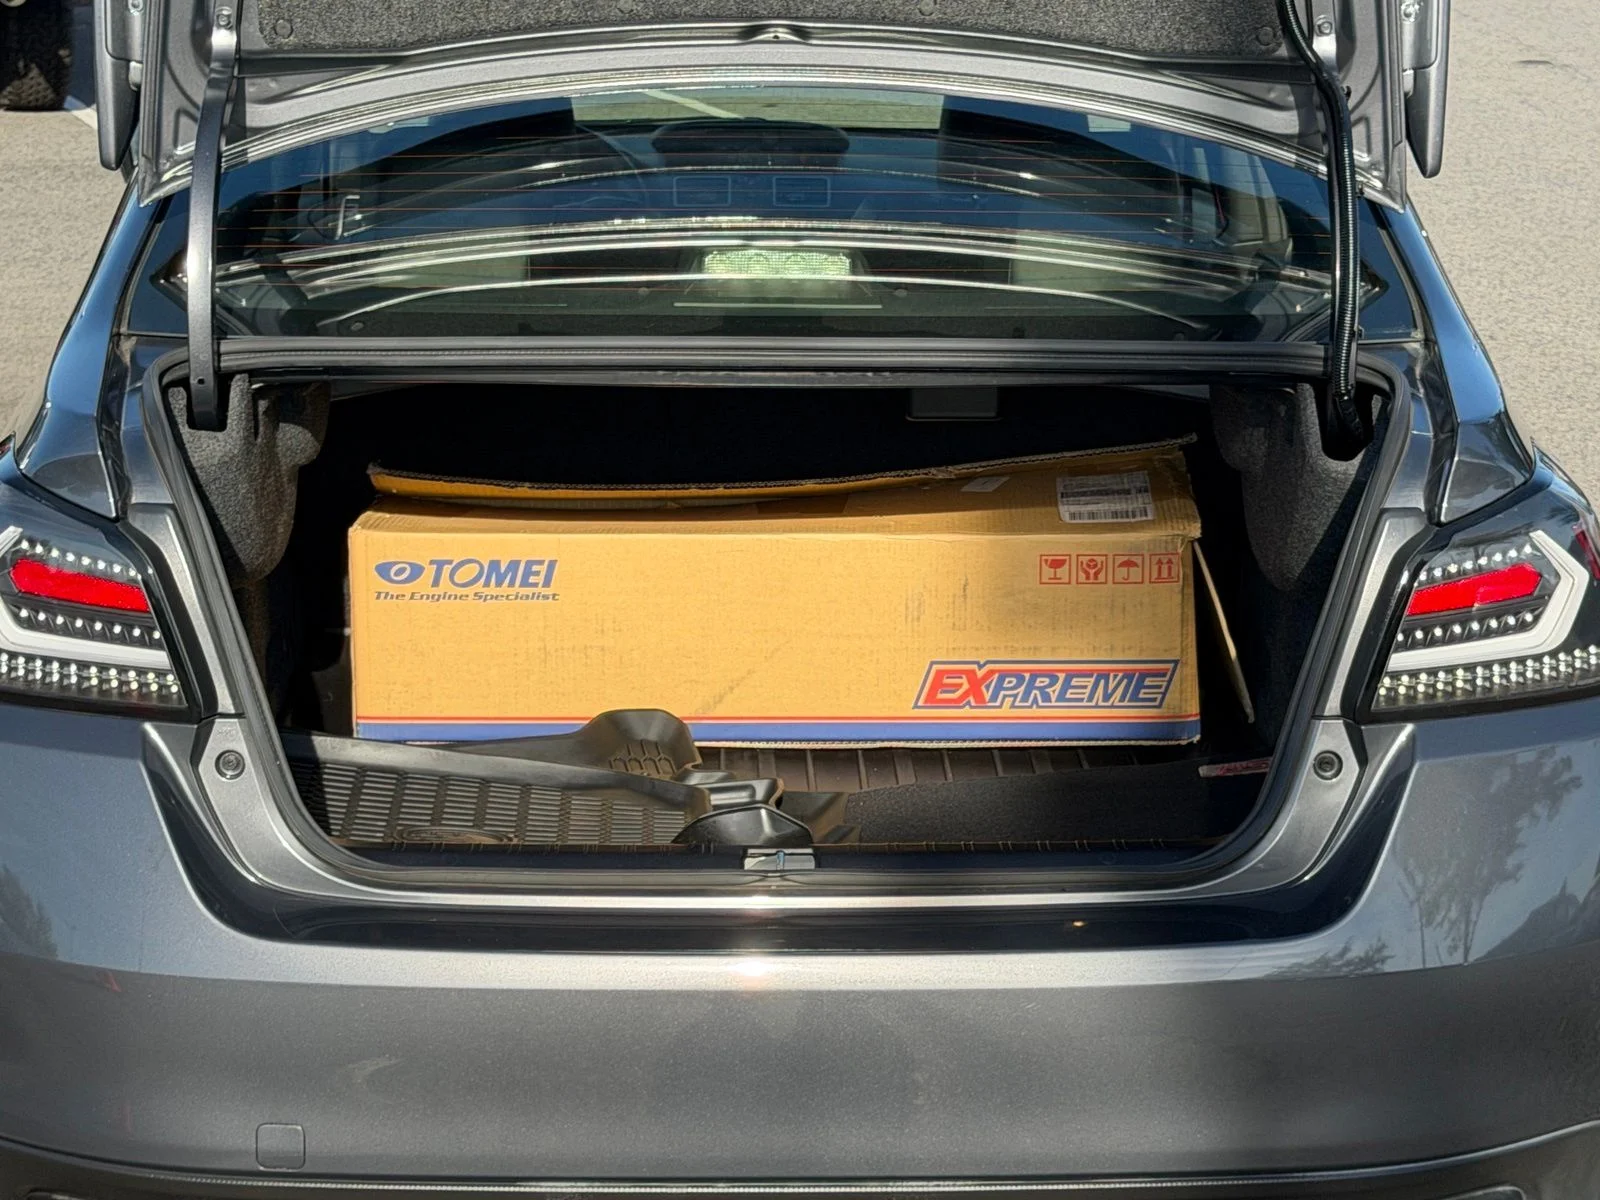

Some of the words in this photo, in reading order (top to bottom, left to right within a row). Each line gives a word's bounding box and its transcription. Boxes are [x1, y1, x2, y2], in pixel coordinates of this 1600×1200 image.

[428, 558, 558, 588] TOMEI
[374, 591, 406, 601] The
[408, 591, 470, 602] Engine
[472, 591, 560, 602] Specialist
[922, 668, 1171, 706] EXPREME
